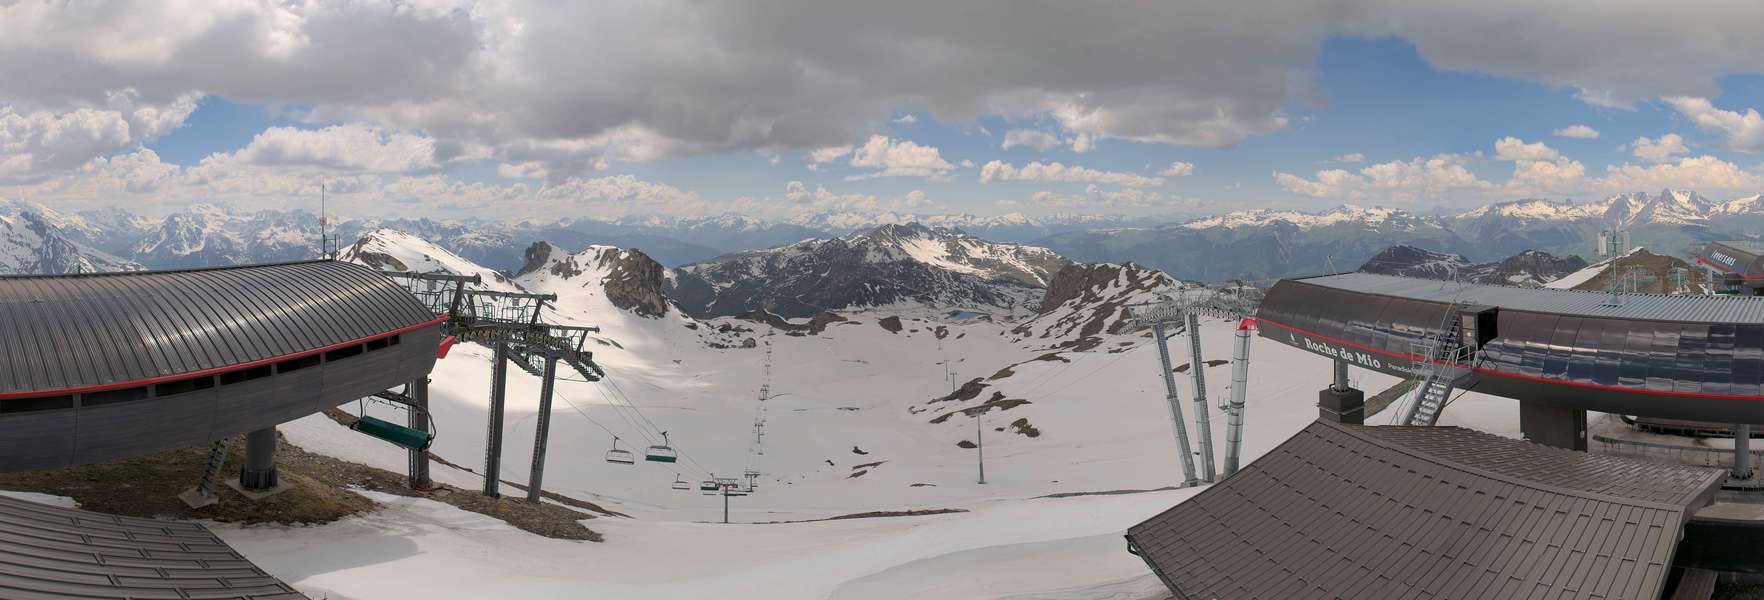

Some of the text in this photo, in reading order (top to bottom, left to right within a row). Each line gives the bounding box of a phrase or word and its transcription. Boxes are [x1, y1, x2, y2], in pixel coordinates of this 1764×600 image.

[1304, 338, 1381, 368] Roche de Mio
